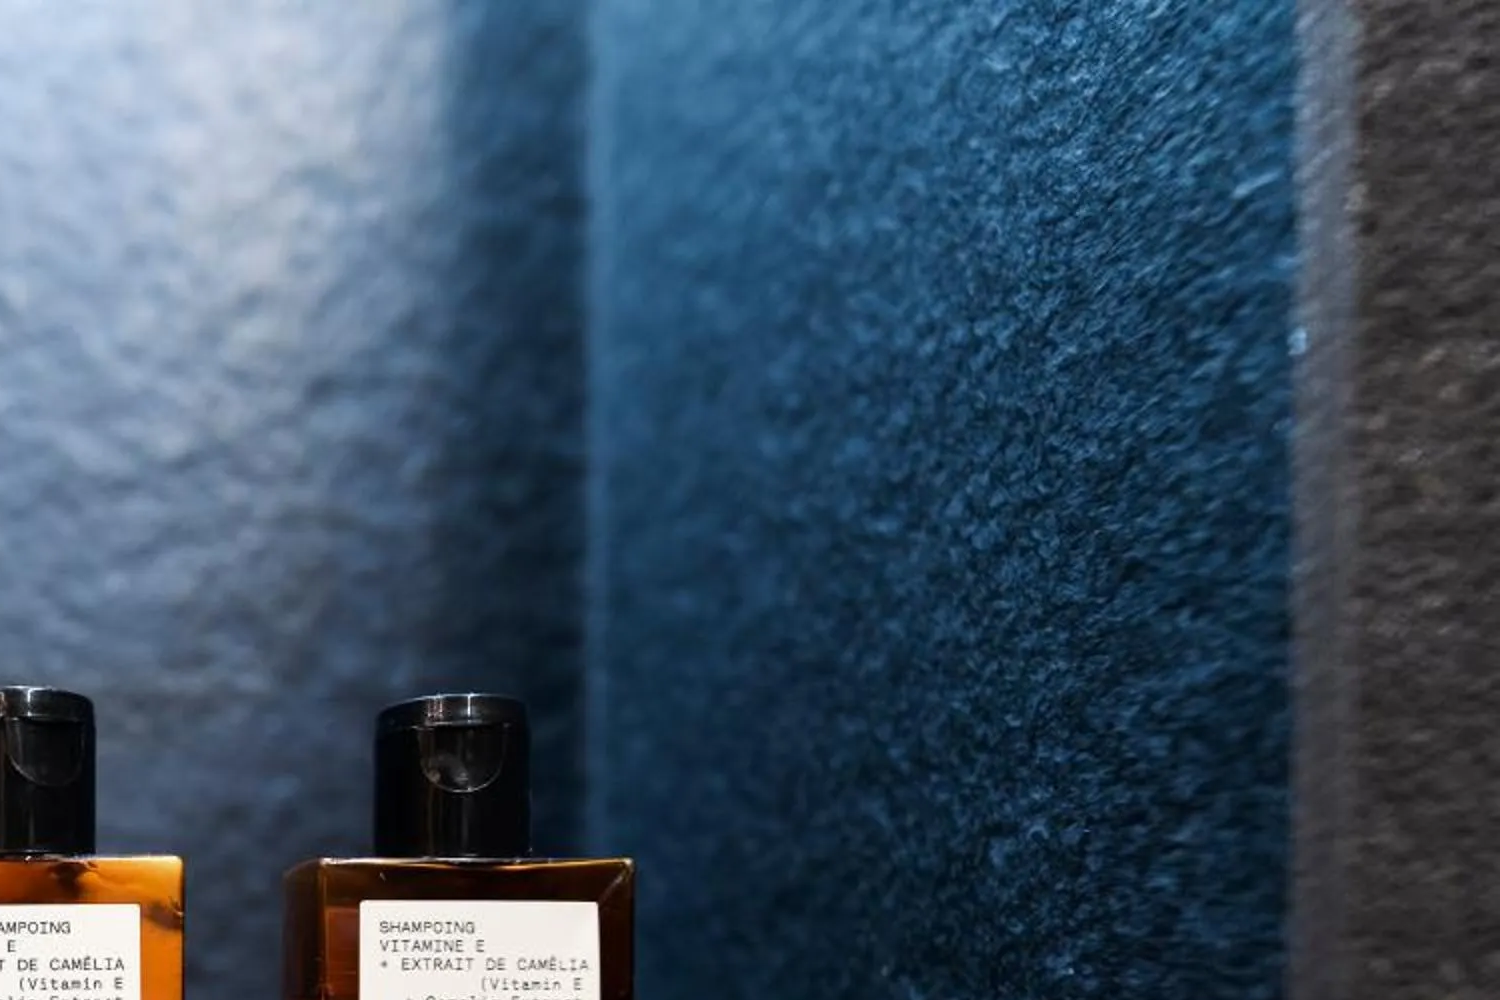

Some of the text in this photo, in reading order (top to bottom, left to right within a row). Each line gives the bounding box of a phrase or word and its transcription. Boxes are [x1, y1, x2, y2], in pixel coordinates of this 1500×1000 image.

[379, 920, 476, 935] SHAMPOING
[6, 939, 17, 953] E
[379, 938, 485, 954] VITAMINE E
[16, 957, 38, 973] DE
[48, 955, 125, 972] CAMÉLIA
[401, 956, 475, 972] EXTRAIT
[485, 957, 506, 972] DE
[517, 956, 589, 972] CAMÉLIA
[19, 976, 123, 992] (Vitamin E
[481, 977, 583, 992] (Vitamin E
